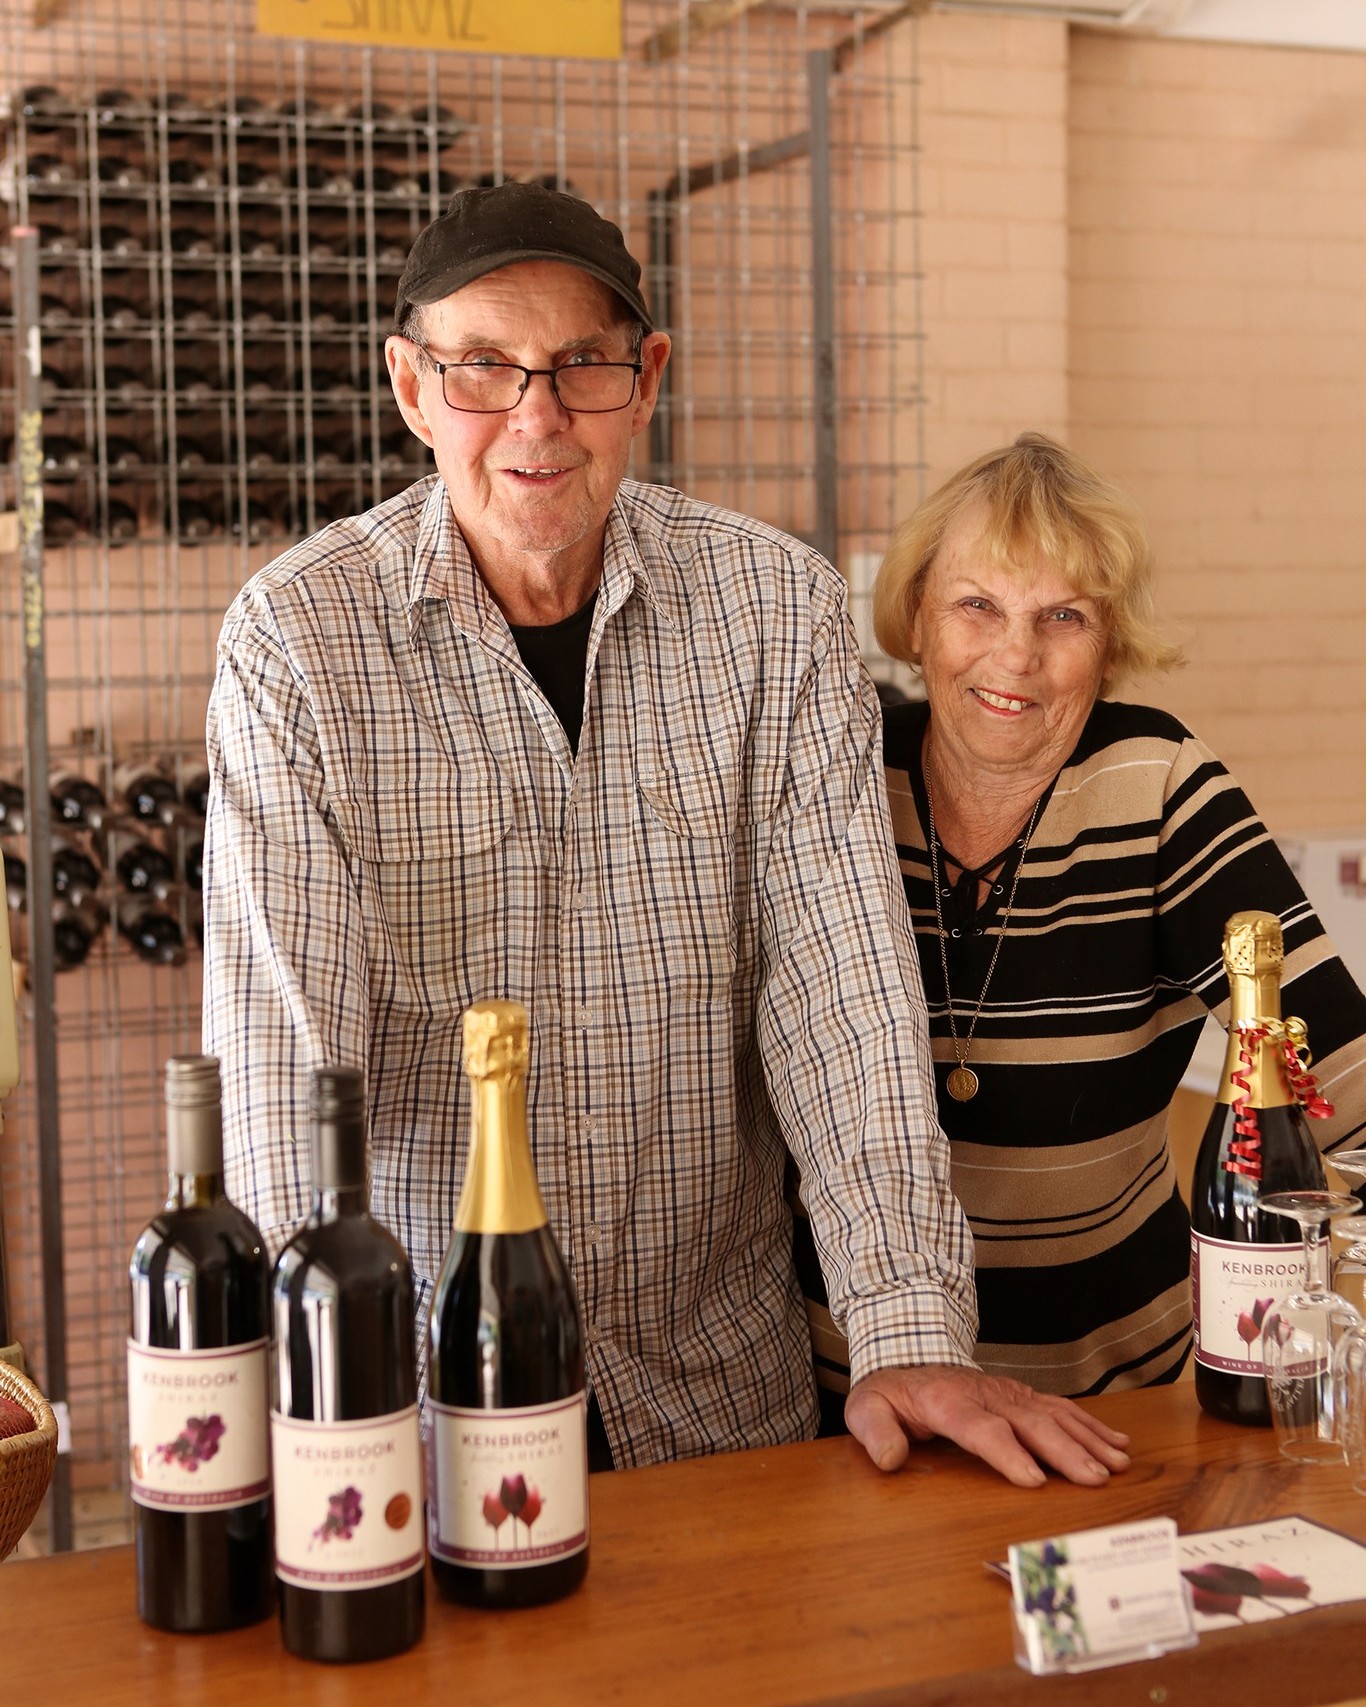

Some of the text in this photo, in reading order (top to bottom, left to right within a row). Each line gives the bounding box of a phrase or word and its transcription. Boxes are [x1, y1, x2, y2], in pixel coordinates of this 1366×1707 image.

[1222, 1260, 1307, 1275] KENBROOK
[1260, 1278, 1304, 1289] SHIRA
[1221, 1359, 1243, 1370] WINE
[144, 1371, 239, 1388] KENBROOK
[462, 1427, 561, 1448] KENBROOK
[294, 1439, 396, 1461] KENBROOK
[1180, 1526, 1310, 1557] HIRAZ
